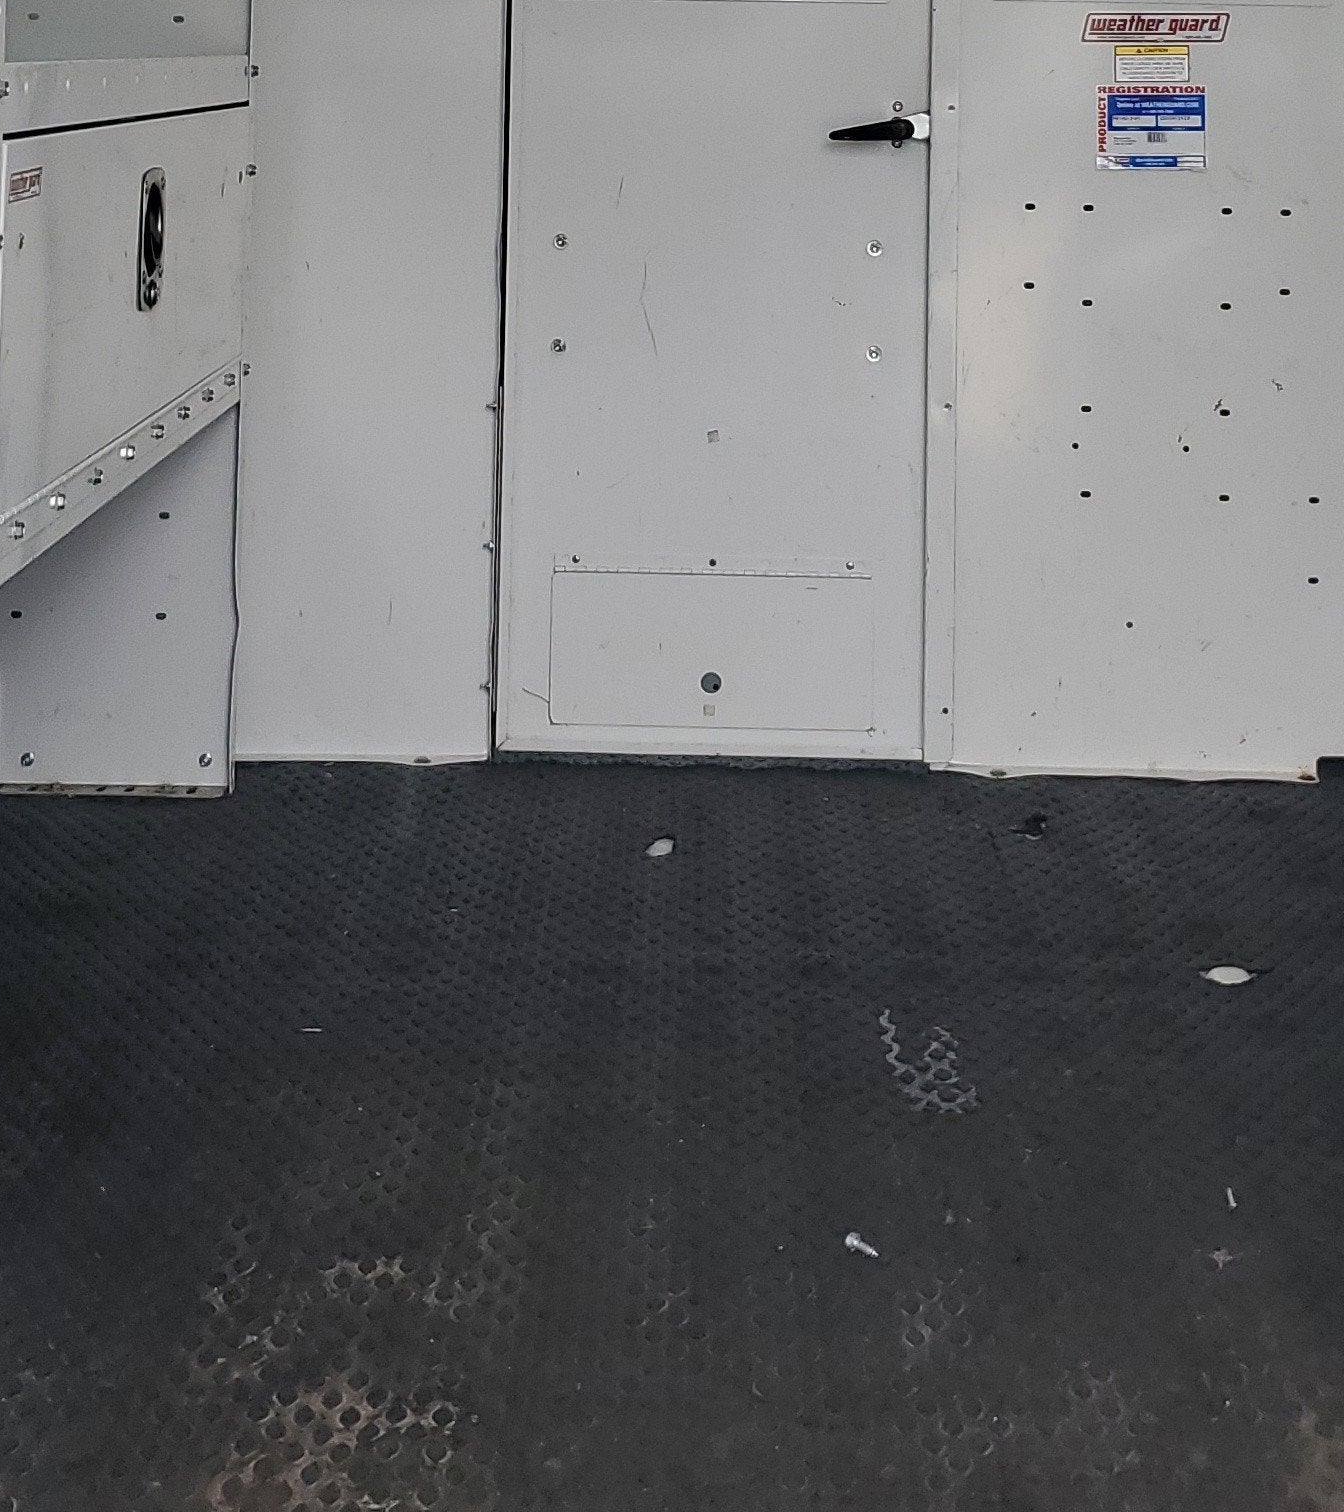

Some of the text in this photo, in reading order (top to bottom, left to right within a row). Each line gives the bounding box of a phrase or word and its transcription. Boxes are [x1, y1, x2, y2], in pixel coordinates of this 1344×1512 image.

[1090, 15, 1221, 34] weather guard
[1097, 86, 1206, 94] REGISTRATION
[1097, 96, 1107, 153] PRODUCT
